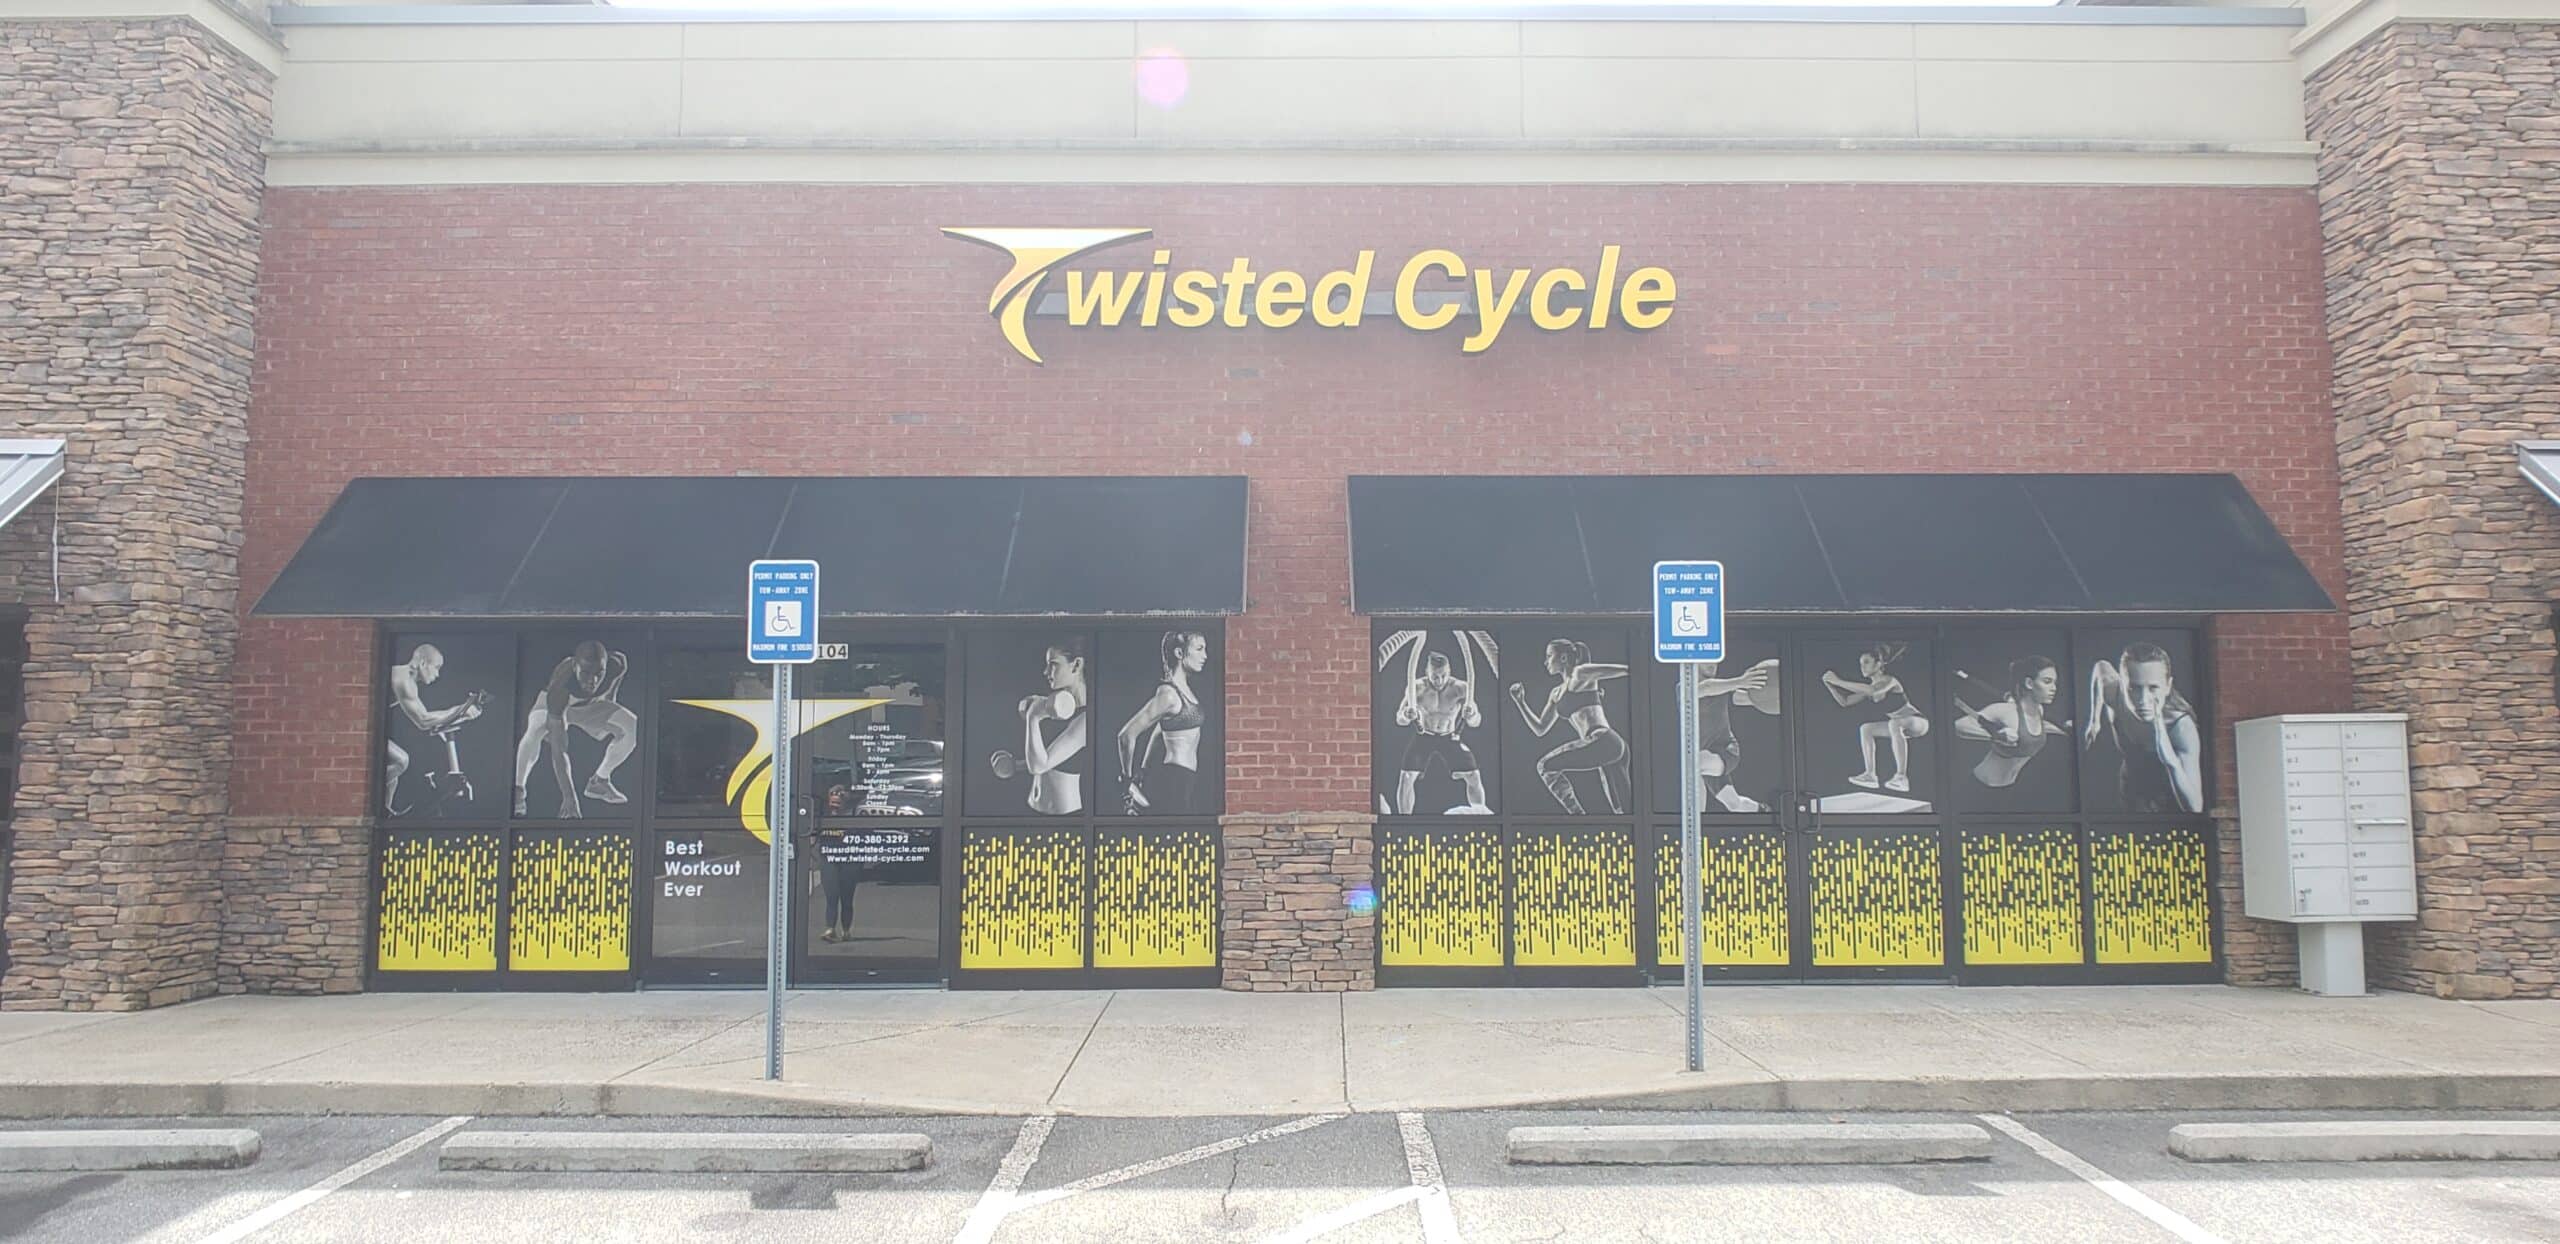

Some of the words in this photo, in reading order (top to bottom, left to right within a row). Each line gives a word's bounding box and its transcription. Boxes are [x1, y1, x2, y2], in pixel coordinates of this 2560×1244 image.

[940, 227, 1375, 364] Twisted
[1394, 245, 1677, 352] Cycle
[818, 645, 847, 658] 104
[843, 834, 909, 844] 470-380-3292
[665, 839, 704, 856] Best
[665, 860, 742, 876] Workout
[664, 882, 704, 897] Ever
